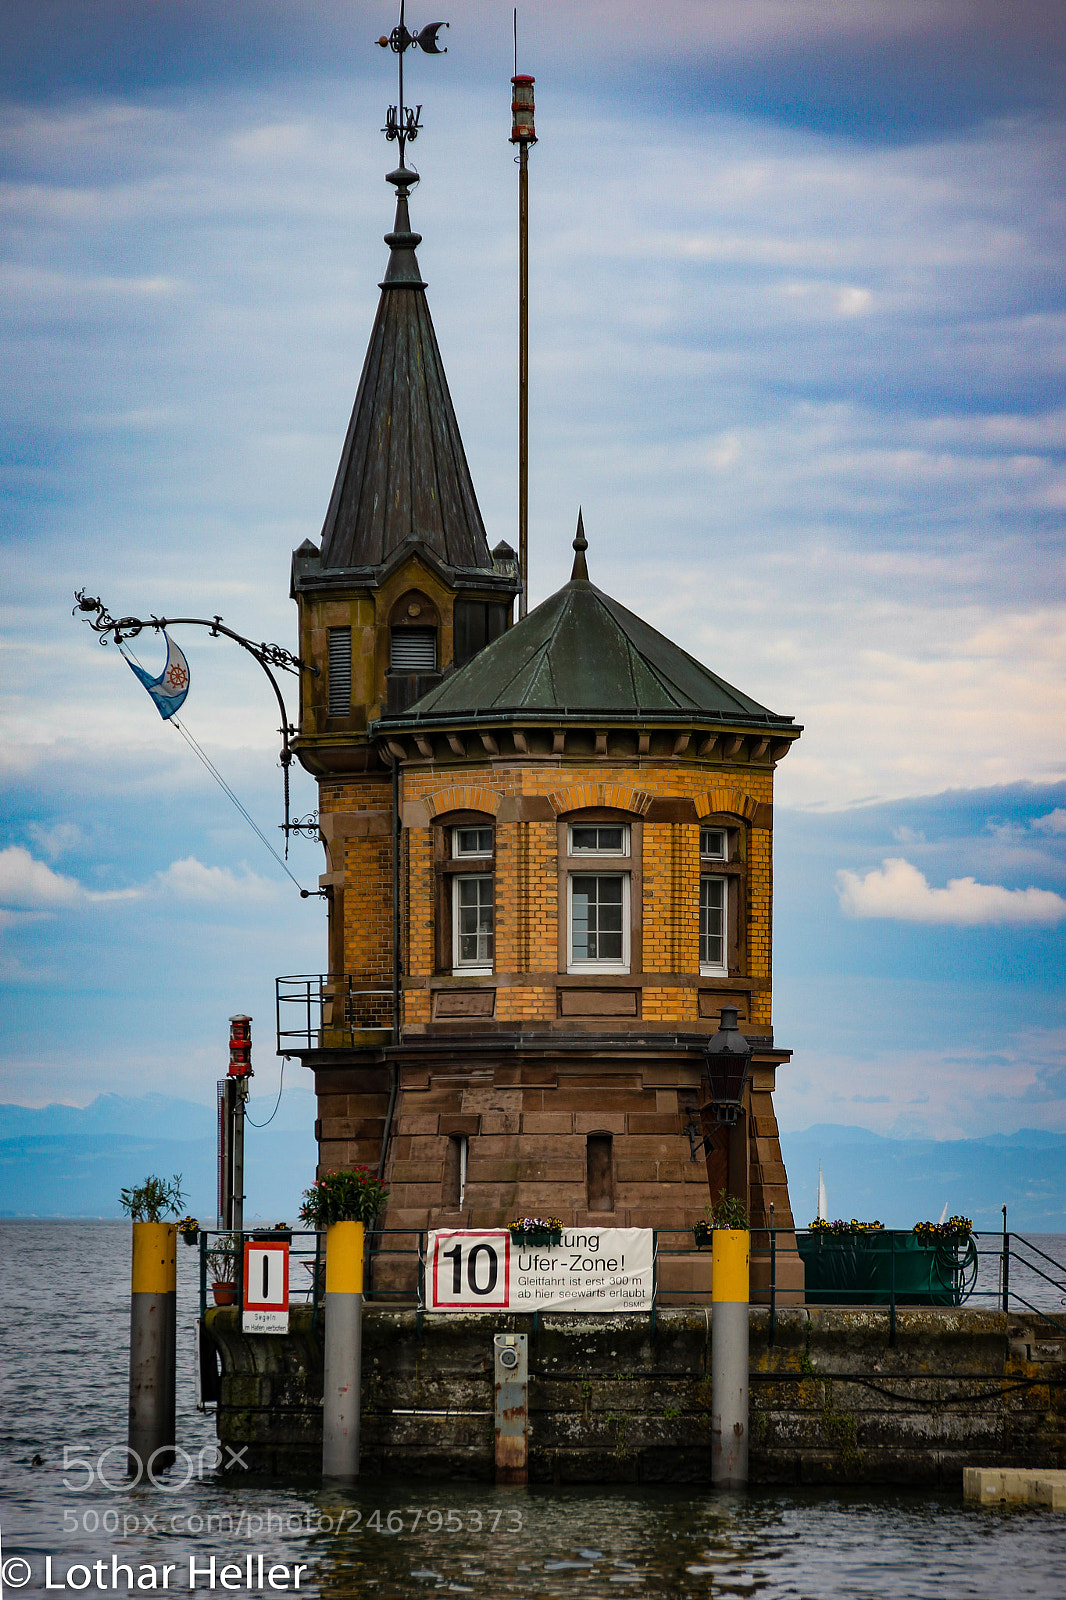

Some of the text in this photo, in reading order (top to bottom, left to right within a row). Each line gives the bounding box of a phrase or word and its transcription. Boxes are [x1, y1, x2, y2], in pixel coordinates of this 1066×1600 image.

[518, 1234, 600, 1252] tung
[443, 1243, 498, 1295] 10
[518, 1254, 625, 1272] Ufer-Zone!
[518, 1276, 642, 1286] Gleitfahrt ist erst 300 m
[517, 1288, 646, 1299] ab hier seewärts erlaubt
